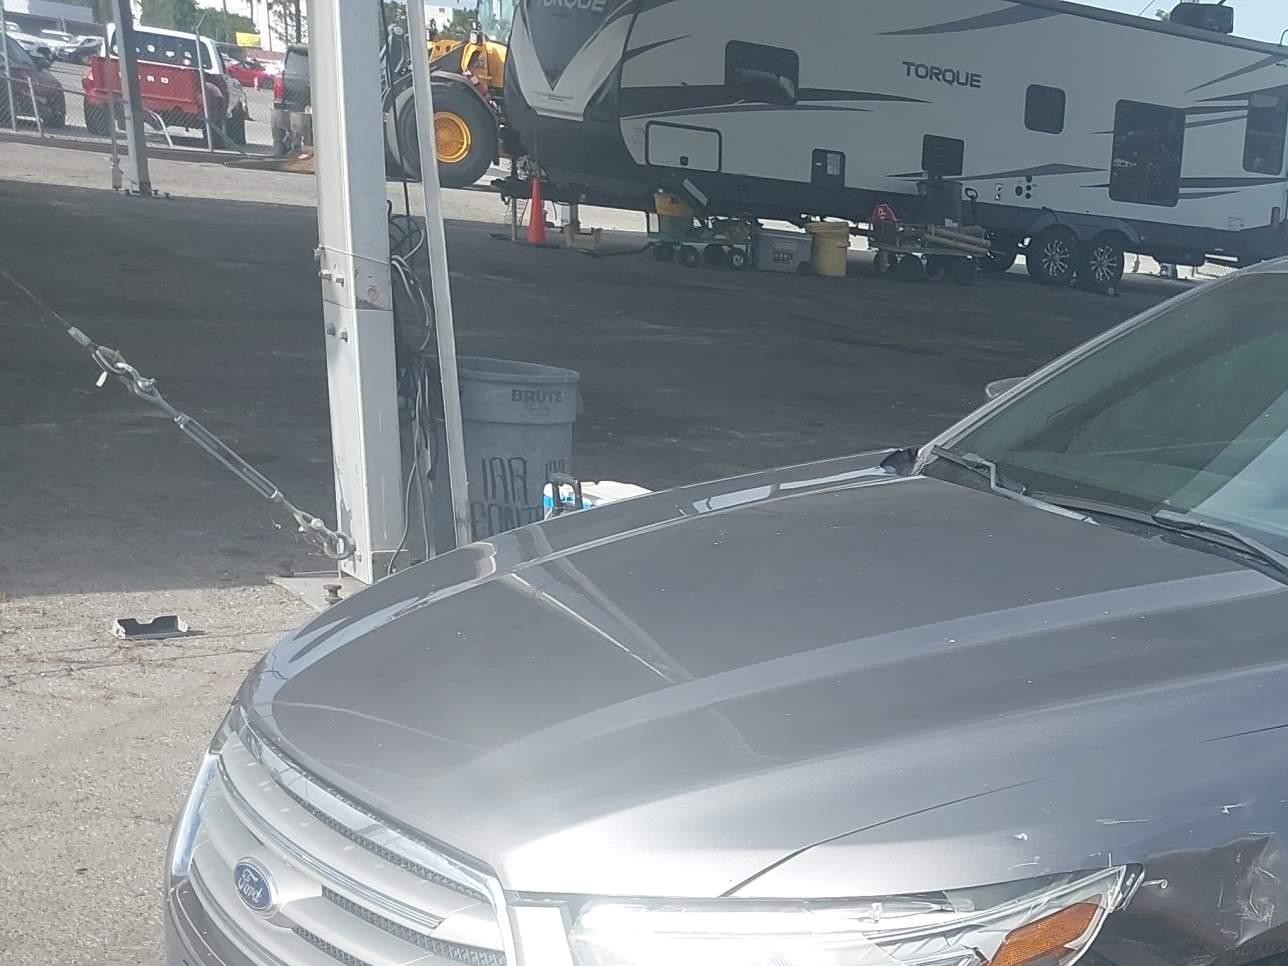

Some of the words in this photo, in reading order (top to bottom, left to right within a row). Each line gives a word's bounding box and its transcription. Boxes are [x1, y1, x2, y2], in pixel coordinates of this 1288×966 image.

[902, 60, 982, 88] TORQUE
[511, 388, 564, 403] BRUTE
[238, 868, 264, 904] Ford
